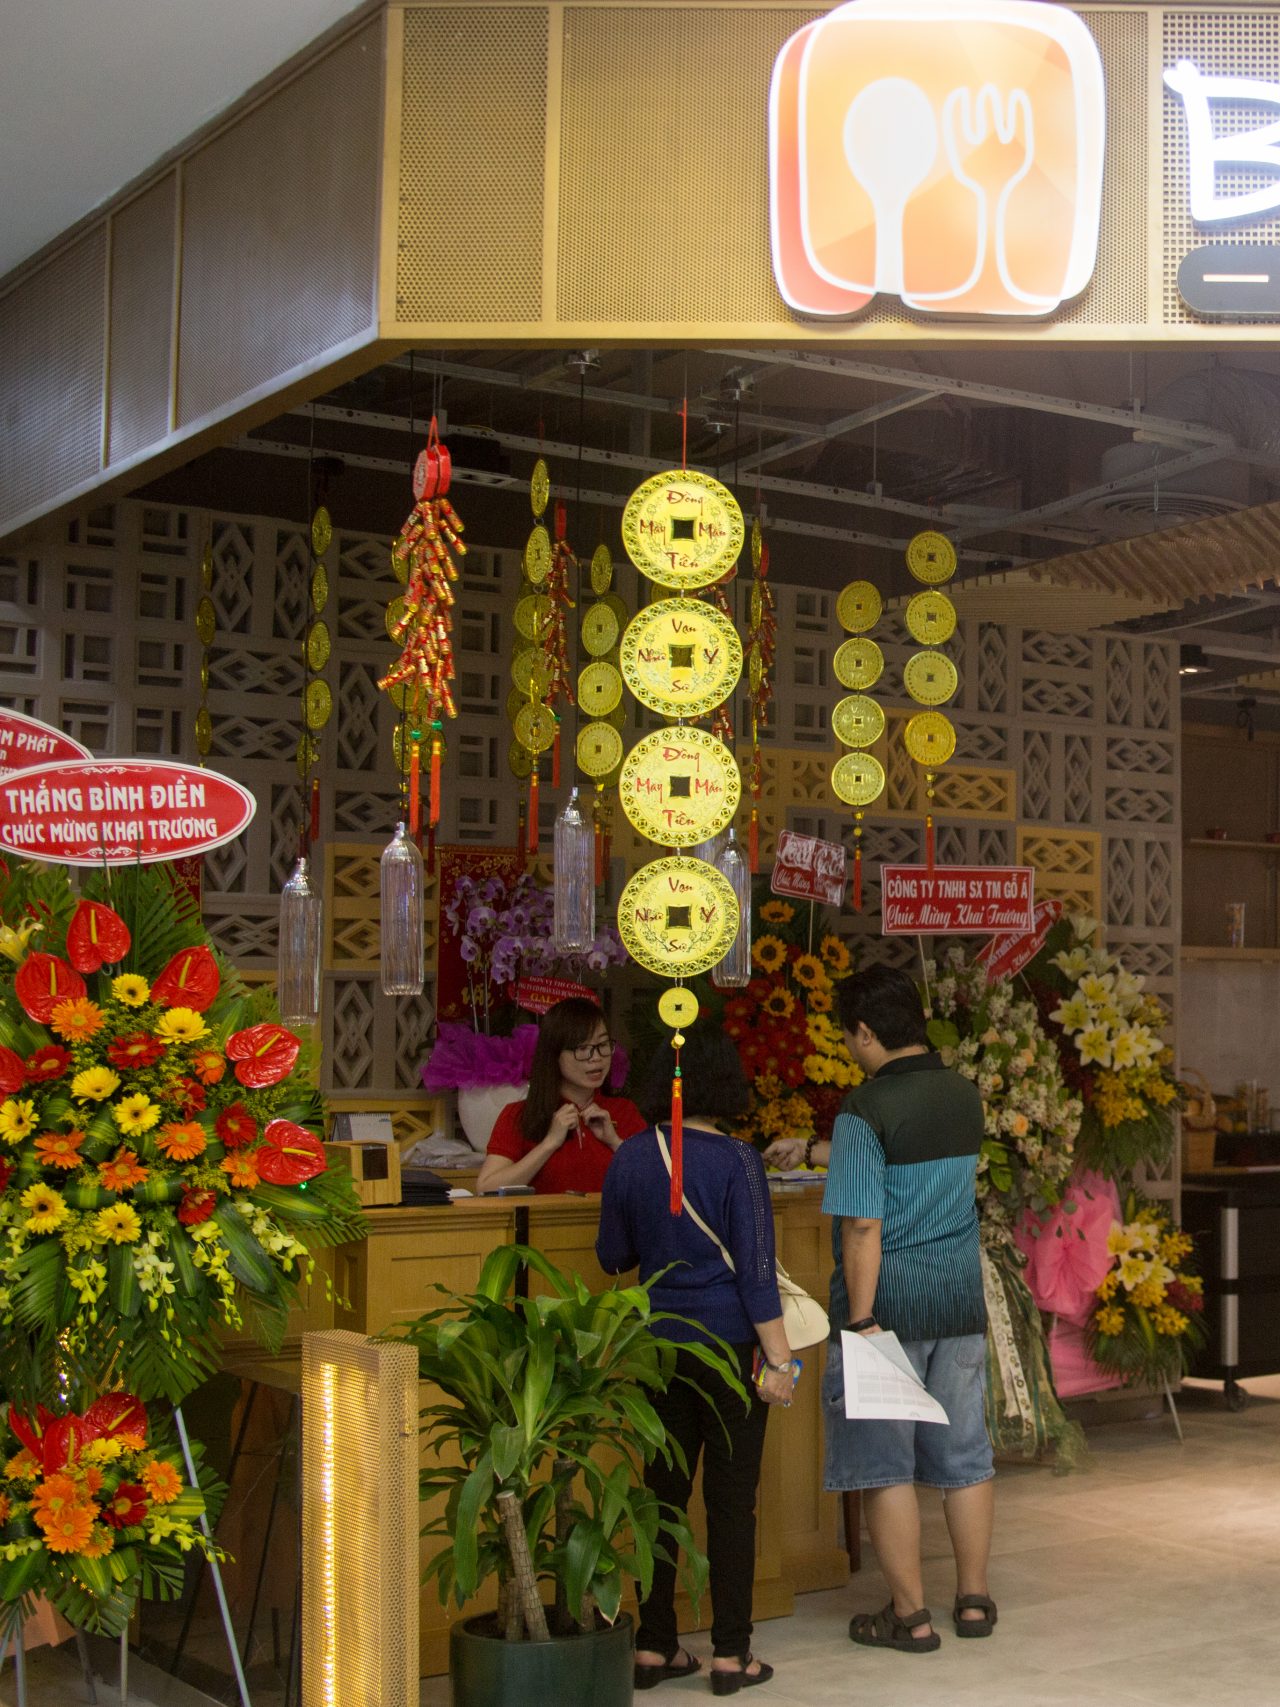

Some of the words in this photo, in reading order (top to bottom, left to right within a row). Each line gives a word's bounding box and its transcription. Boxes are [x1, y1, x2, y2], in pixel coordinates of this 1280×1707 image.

[17, 734, 58, 754] PHÁT
[89, 781, 144, 812] BÌNH
[151, 775, 205, 809] ĐIỀN
[2, 819, 45, 845] CHÚC
[50, 818, 98, 843] MỪNG
[102, 821, 144, 843] KHAI
[148, 817, 218, 841] TRƯƠNG
[888, 875, 917, 898] CÔNG
[920, 880, 934, 898] TY
[938, 880, 966, 898] TNHH
[969, 880, 983, 898] SX
[986, 881, 1001, 898] TM
[1021, 877, 1028, 898] Á
[887, 904, 914, 928] Chúc
[916, 904, 951, 929] Mừng
[953, 904, 984, 925] Khai
[987, 904, 1028, 929] Trương
